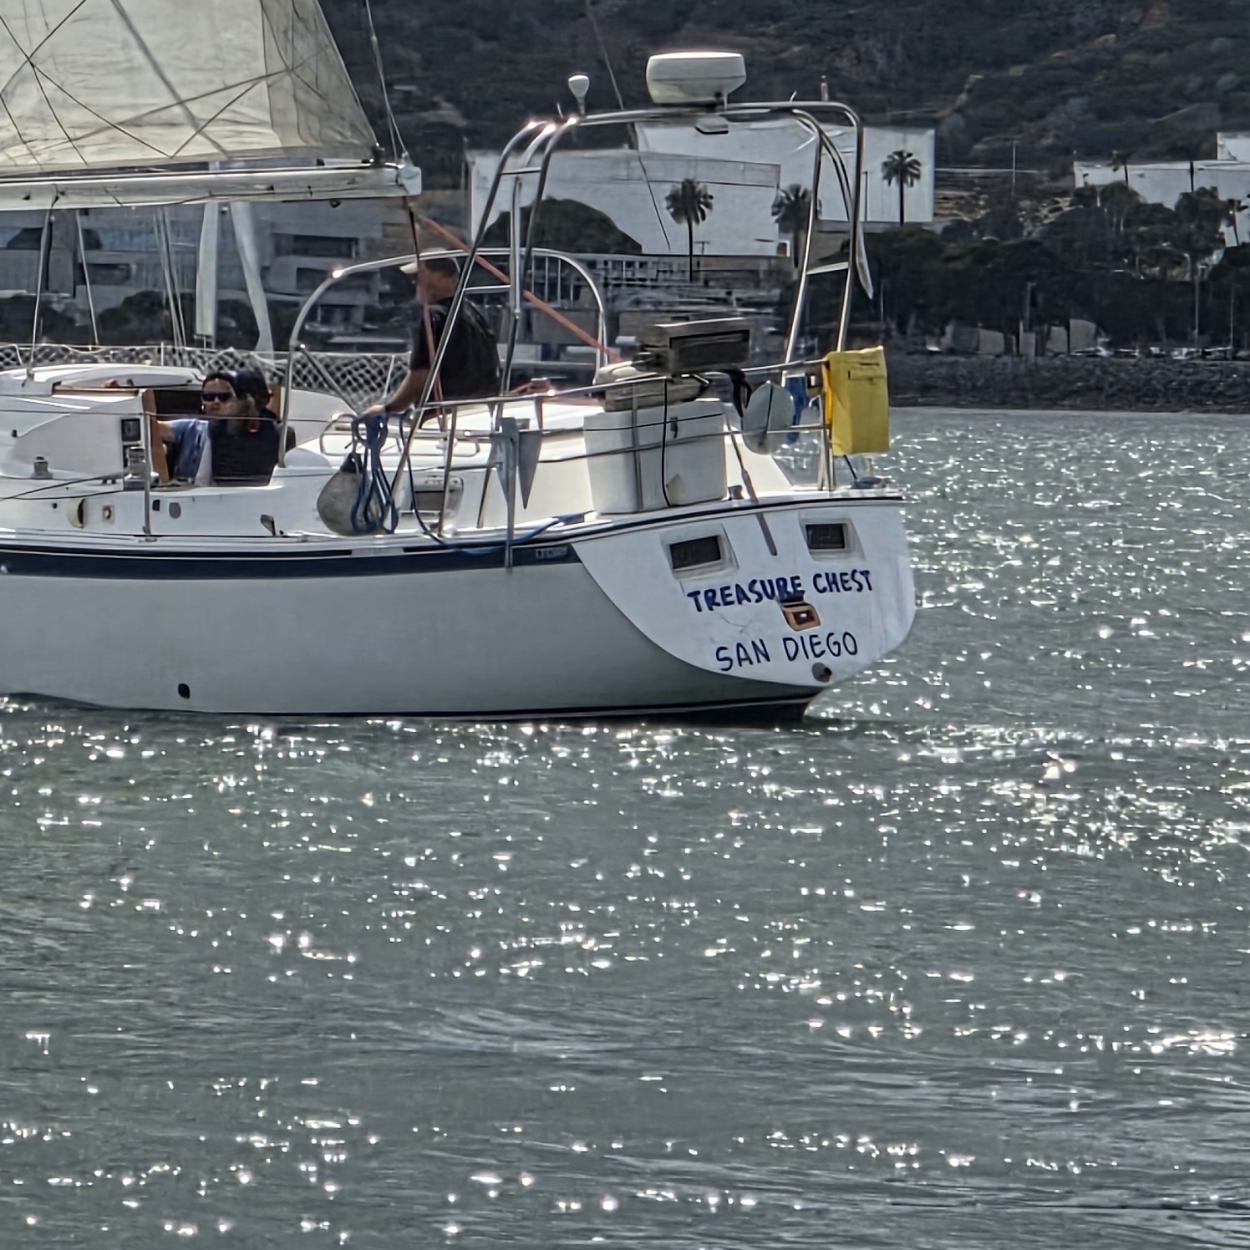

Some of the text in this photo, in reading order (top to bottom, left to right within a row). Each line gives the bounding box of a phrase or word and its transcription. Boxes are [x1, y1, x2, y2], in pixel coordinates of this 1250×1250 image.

[686, 569, 873, 613] TREASURE CHEST
[715, 630, 859, 672] SAN DIEGO
